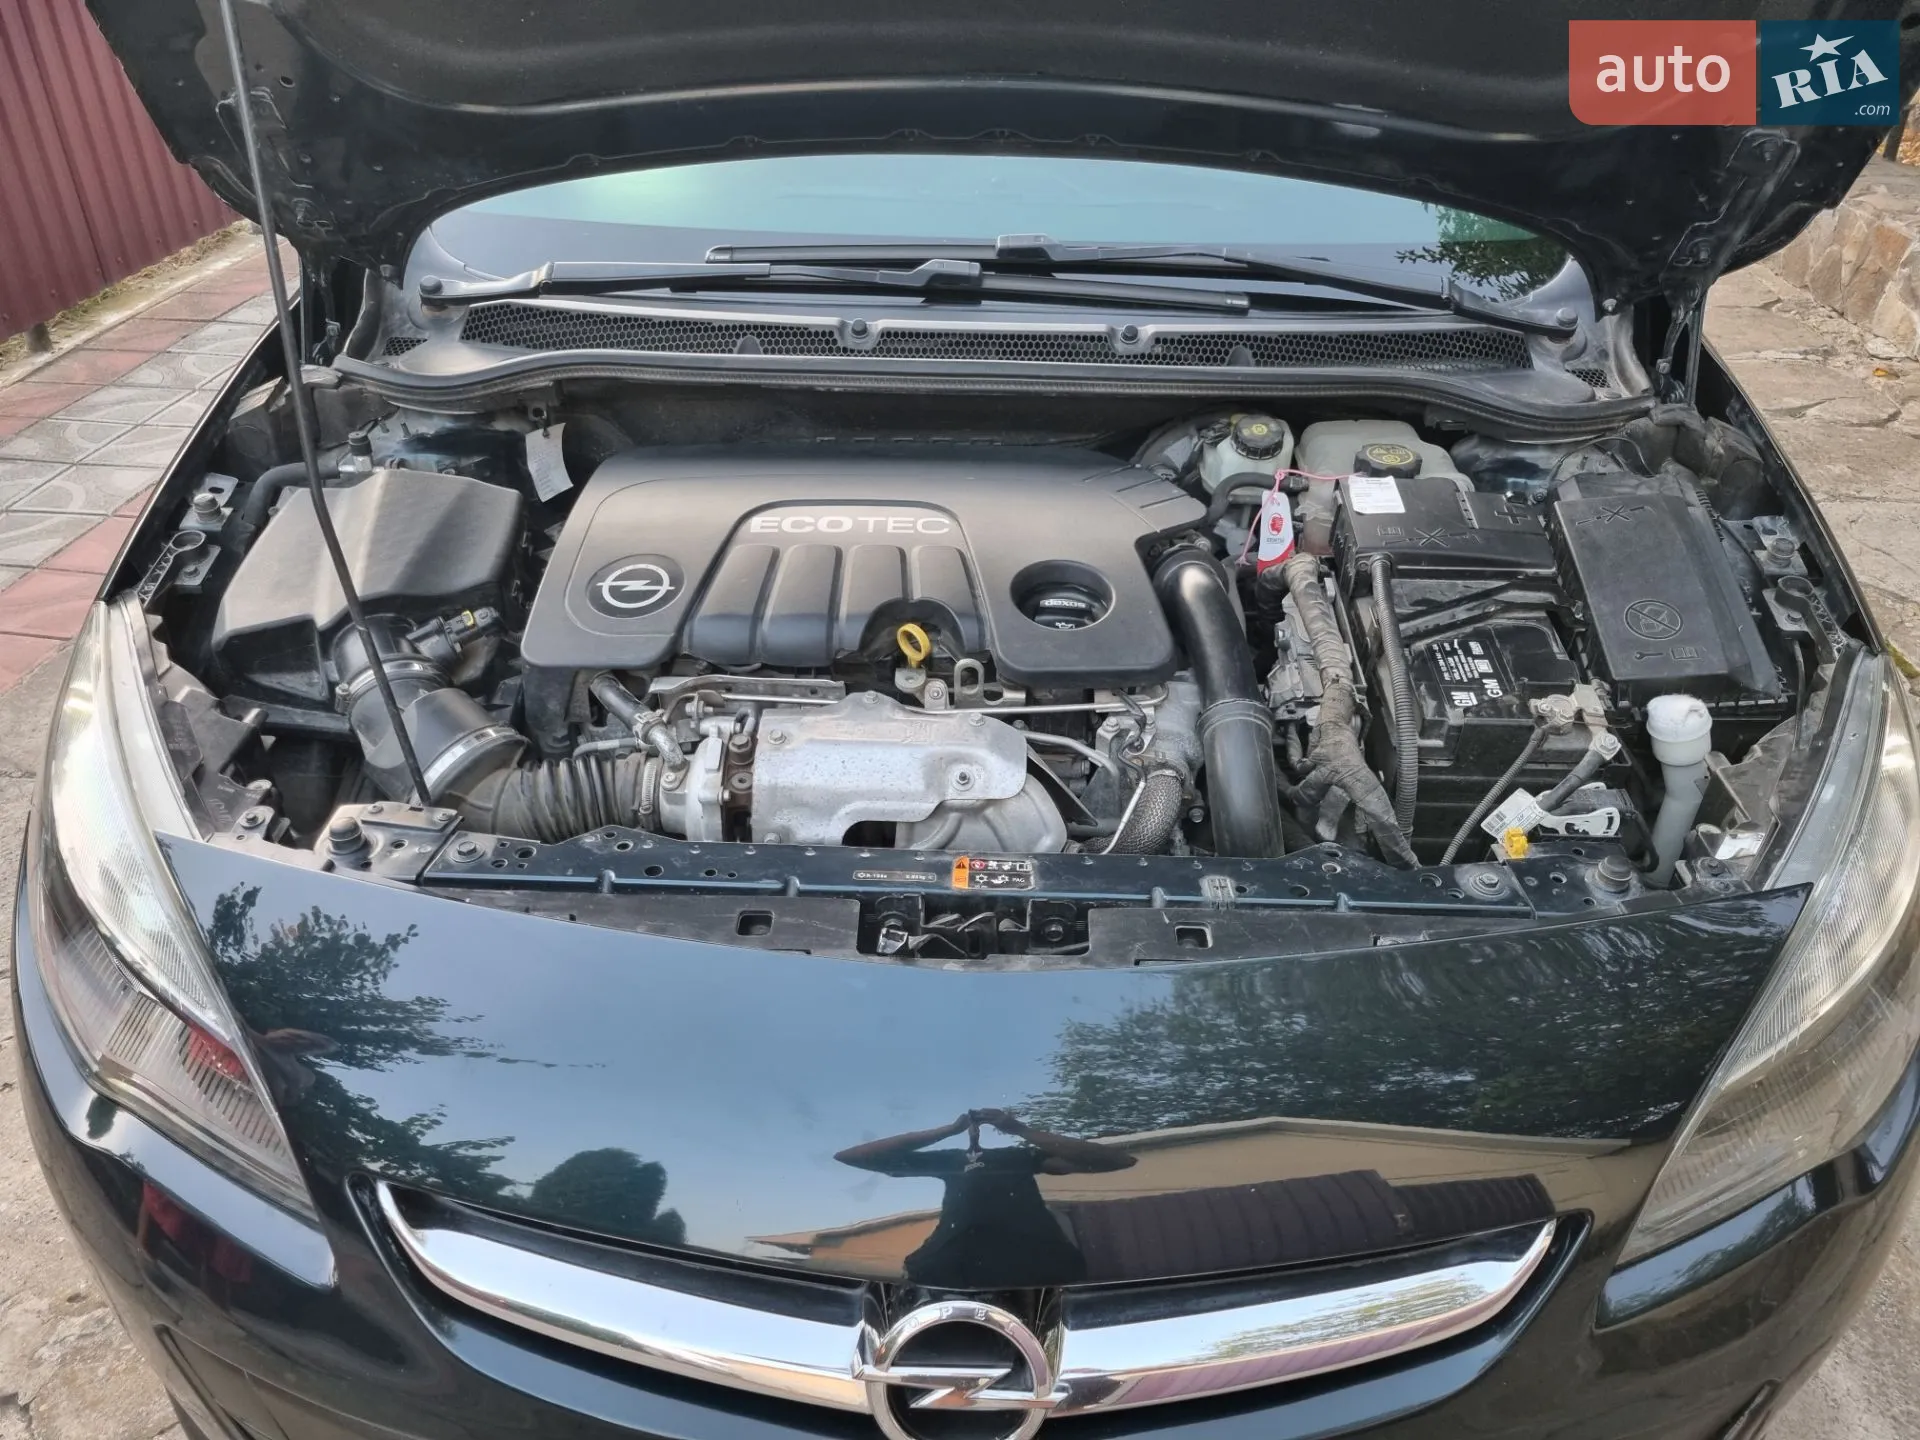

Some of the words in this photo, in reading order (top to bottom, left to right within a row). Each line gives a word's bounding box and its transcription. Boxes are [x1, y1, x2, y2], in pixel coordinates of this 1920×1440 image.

[749, 515, 951, 535] ECOTEC
[1044, 598, 1086, 609] dexos
[1482, 679, 1503, 698] GM
[1450, 691, 1474, 706] GM
[906, 1305, 1016, 1335] OPEL
